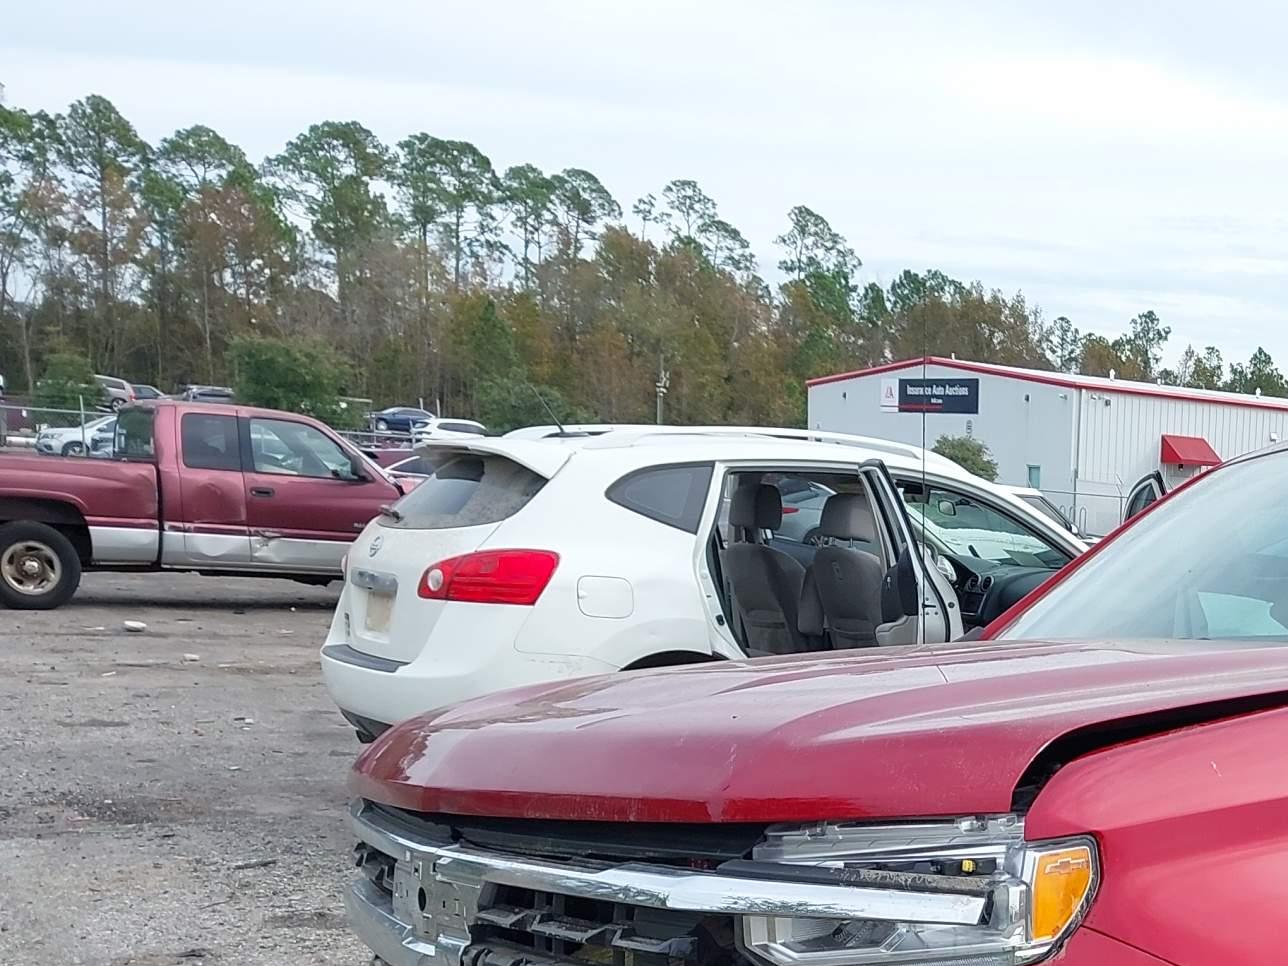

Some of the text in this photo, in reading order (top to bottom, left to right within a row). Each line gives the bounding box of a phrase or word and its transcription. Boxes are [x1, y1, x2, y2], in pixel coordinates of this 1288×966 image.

[906, 384, 931, 396] Insurace
[932, 384, 944, 396] Auto
[945, 384, 969, 396] Auctions
